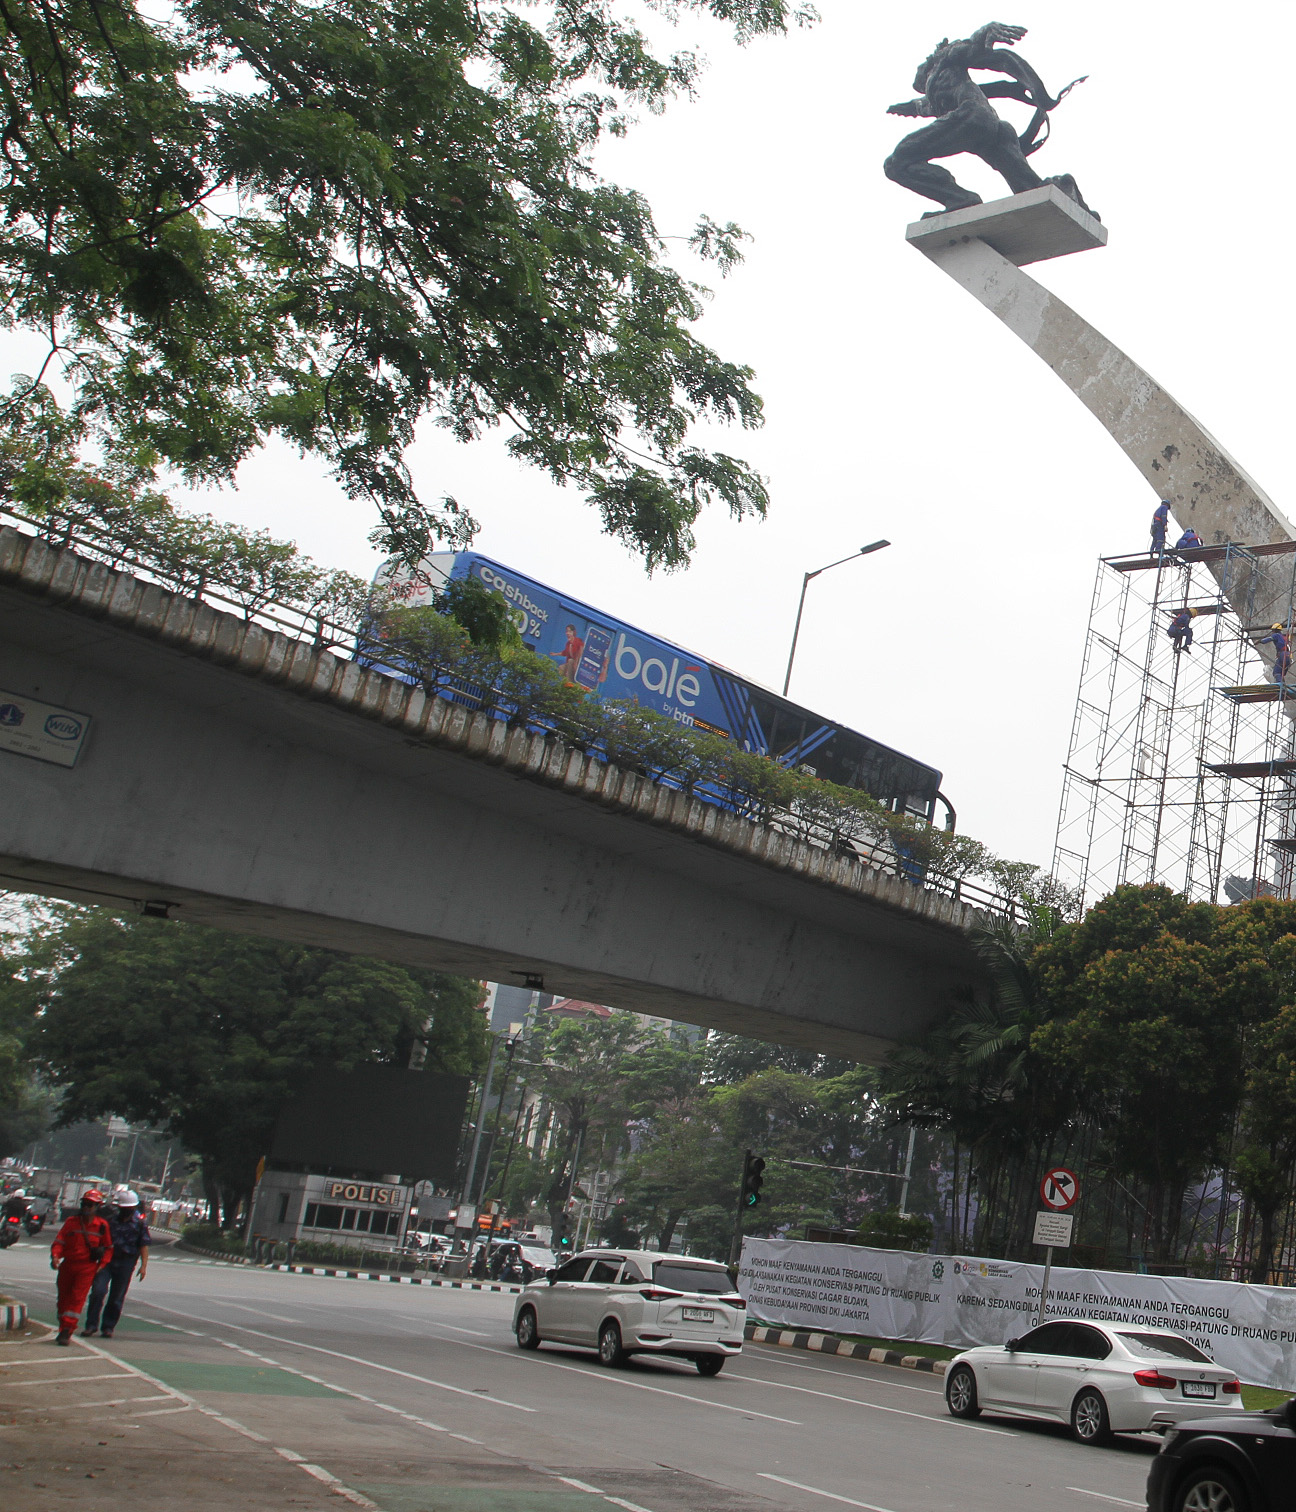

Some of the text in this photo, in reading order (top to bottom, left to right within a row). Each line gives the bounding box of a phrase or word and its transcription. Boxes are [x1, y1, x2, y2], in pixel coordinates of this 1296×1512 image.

[480, 566, 549, 623] cashback
[663, 702, 695, 727] by btn
[49, 719, 79, 735] WIKA
[331, 1183, 396, 1205] POLISI
[783, 1260, 820, 1274] KENYAMANAN
[821, 1266, 840, 1277] ANDA
[842, 1268, 883, 1282] TERGANGGU
[782, 1286, 818, 1300] KONSERVASI
[818, 1290, 843, 1303] CAGAR
[785, 1273, 812, 1286] KEGIATAN
[813, 1278, 853, 1292] KONSERVASI
[854, 1283, 880, 1296] PATUNG
[881, 1287, 889, 1297] DI
[890, 1288, 913, 1300] RUANG
[914, 1291, 941, 1304] PUBLIK
[799, 1302, 828, 1316] PROVINSI
[829, 1307, 840, 1317] DKI
[841, 1308, 870, 1321] JAKARTA
[1056, 1290, 1080, 1302] MAAF
[1082, 1293, 1141, 1310] KENYAMANAN
[1143, 1299, 1169, 1313] ANDA
[1170, 1301, 1230, 1319] TERGANGGU
[957, 1293, 986, 1308] KARENA
[987, 1297, 1021, 1312] SEDANG
[1022, 1301, 1086, 1318] DILASANAKAN
[1088, 1308, 1131, 1323] KEGIATAN
[1132, 1313, 1189, 1331] KONSERVASI
[1190, 1320, 1228, 1336] PATUNG
[1231, 1325, 1240, 1337] DI
[1242, 1326, 1278, 1341] RUANG
